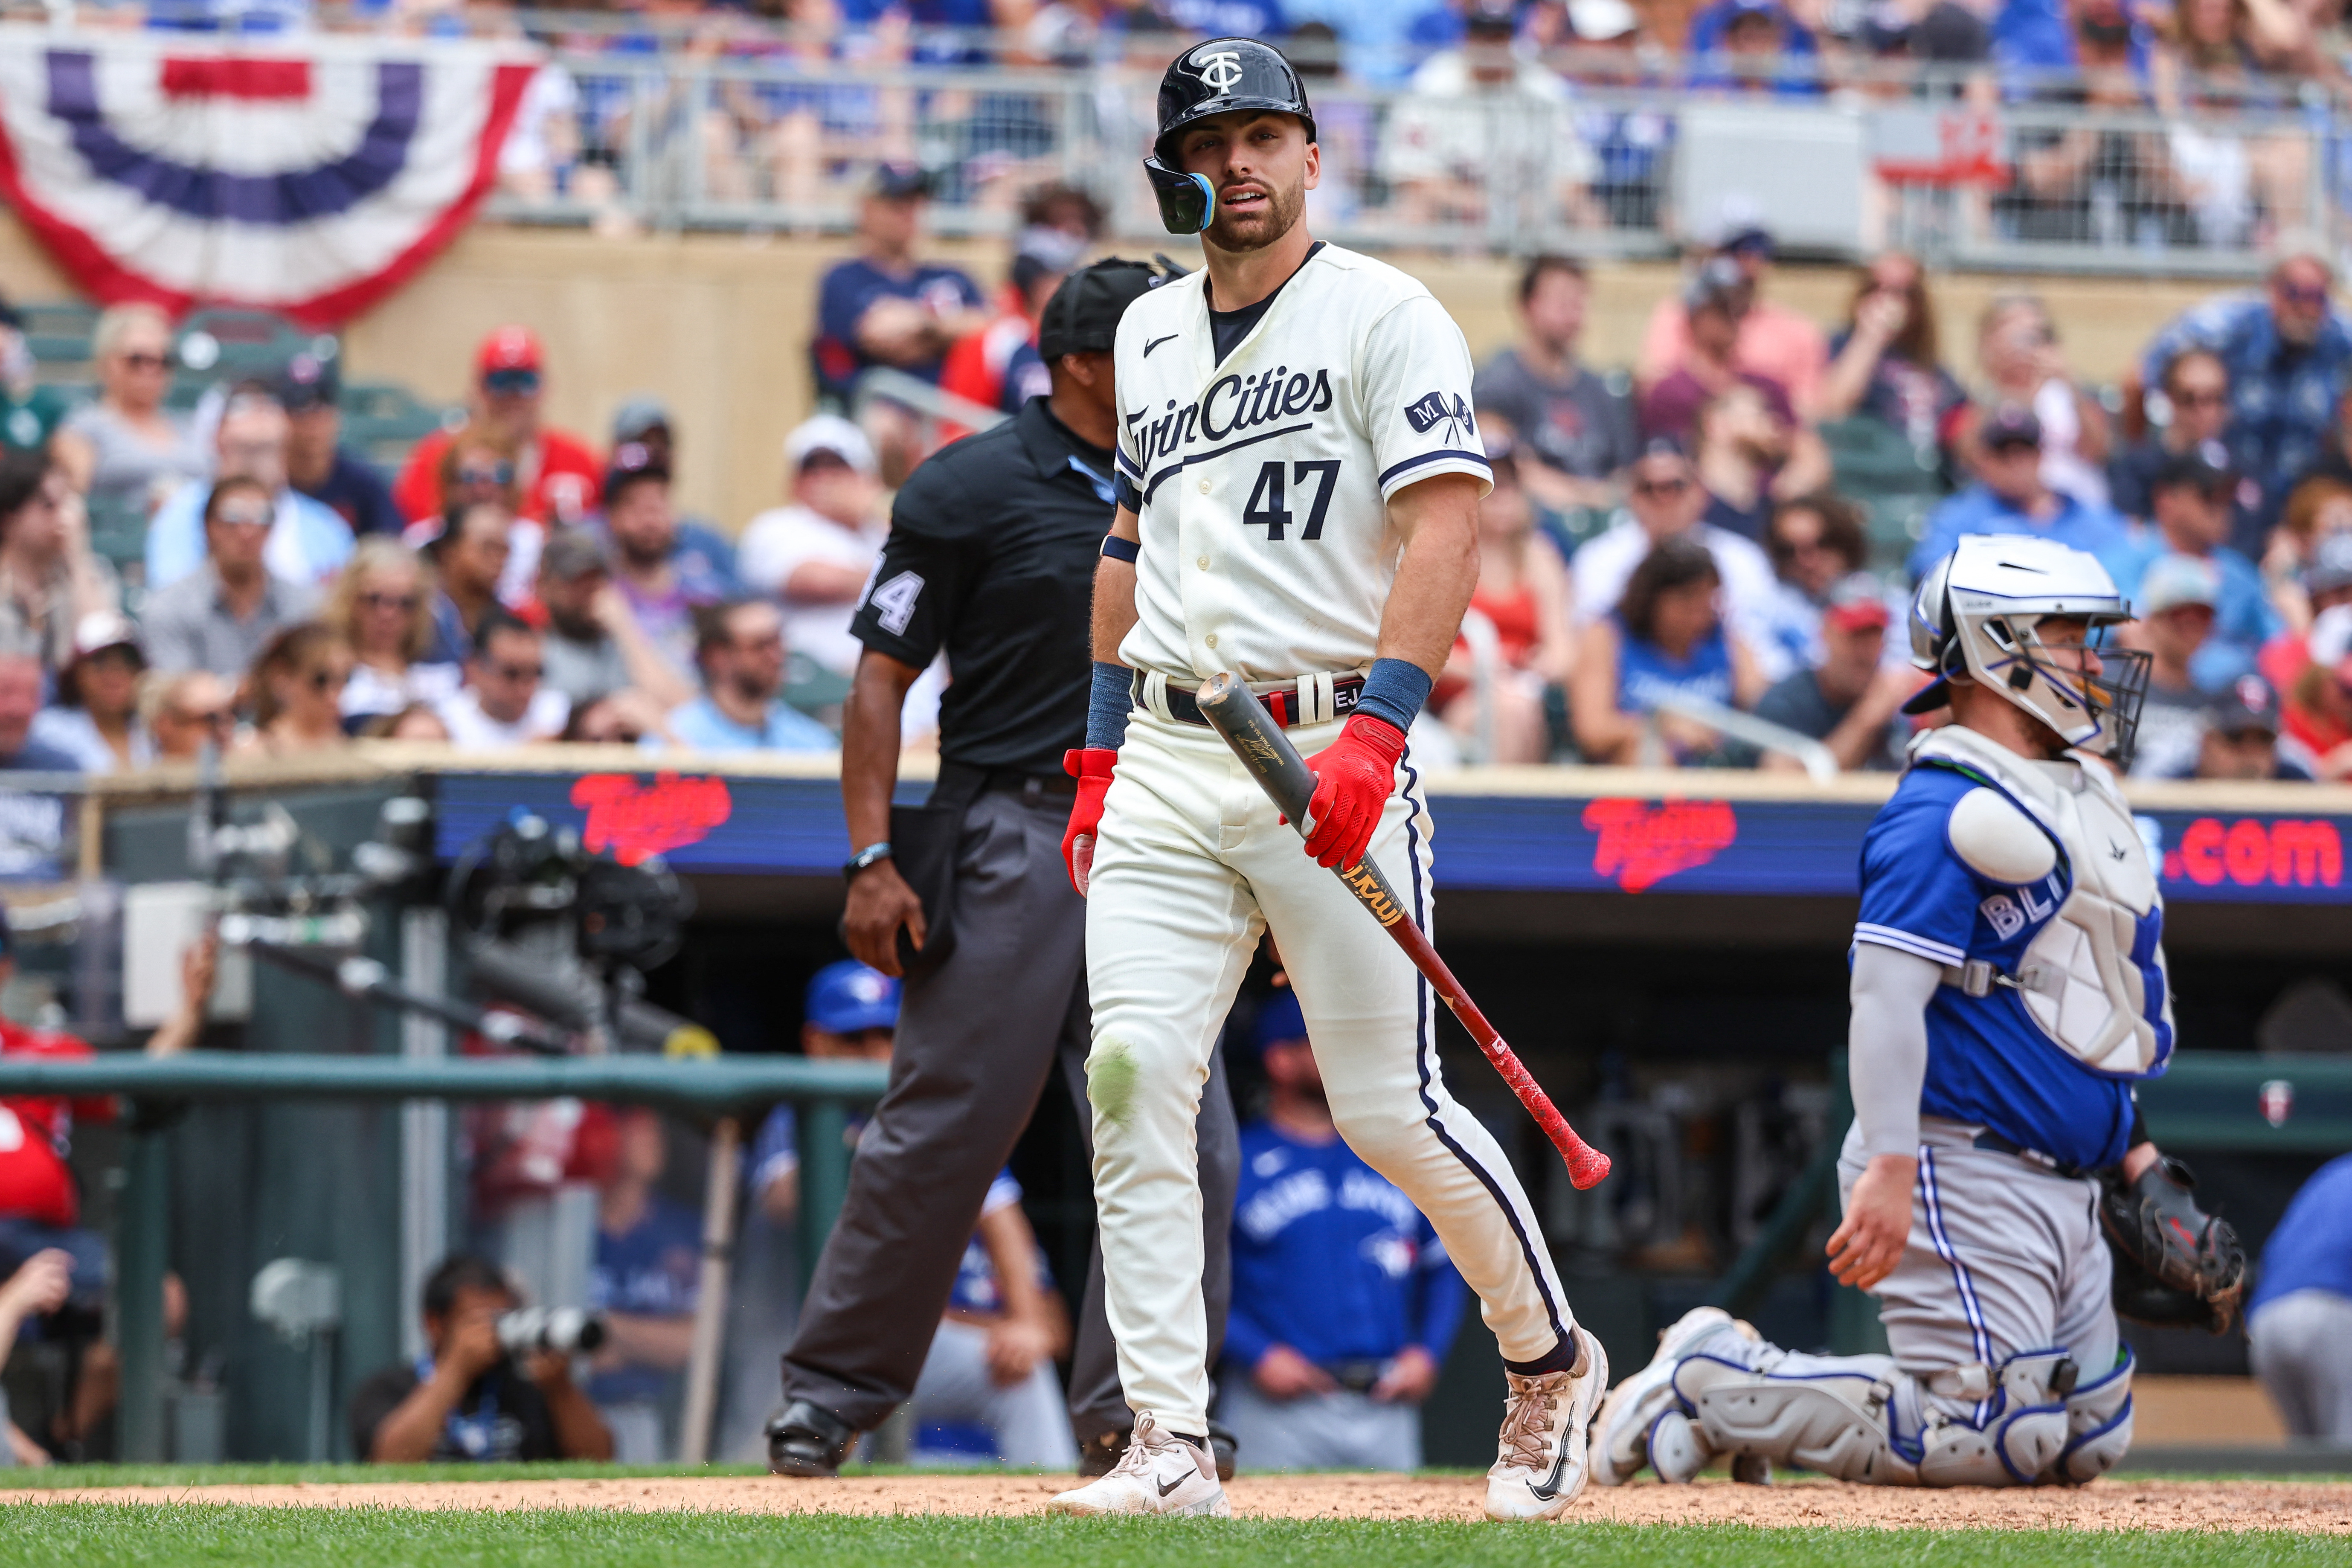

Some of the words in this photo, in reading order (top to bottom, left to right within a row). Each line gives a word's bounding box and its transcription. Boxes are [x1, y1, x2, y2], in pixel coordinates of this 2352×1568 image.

[1201, 366, 1332, 441] Cities
[1413, 400, 1439, 426] M
[1243, 460, 1341, 540] 47
